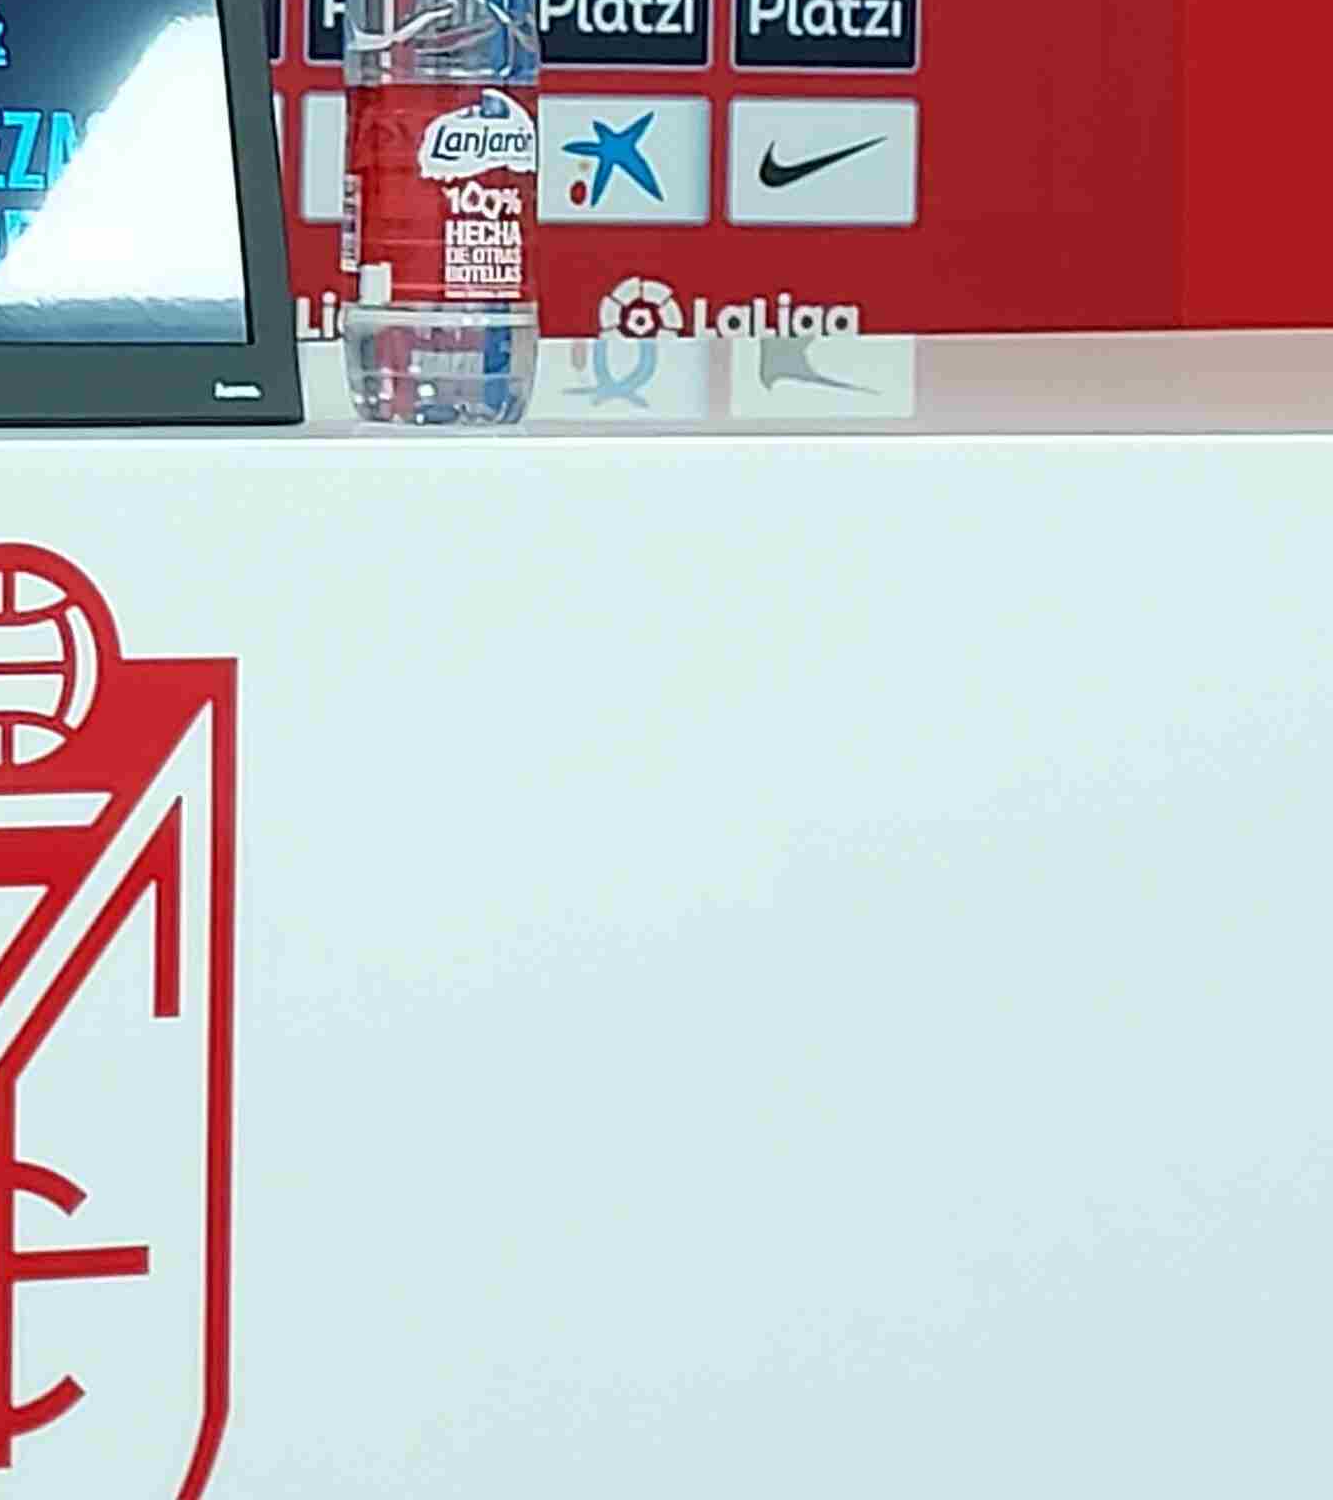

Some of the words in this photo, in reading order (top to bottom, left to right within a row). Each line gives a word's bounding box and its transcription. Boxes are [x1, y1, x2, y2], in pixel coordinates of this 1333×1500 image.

[441, 181, 522, 219] 100%
[445, 220, 522, 246] HECHA
[445, 247, 471, 264] DE
[694, 294, 860, 339] LaLiga
